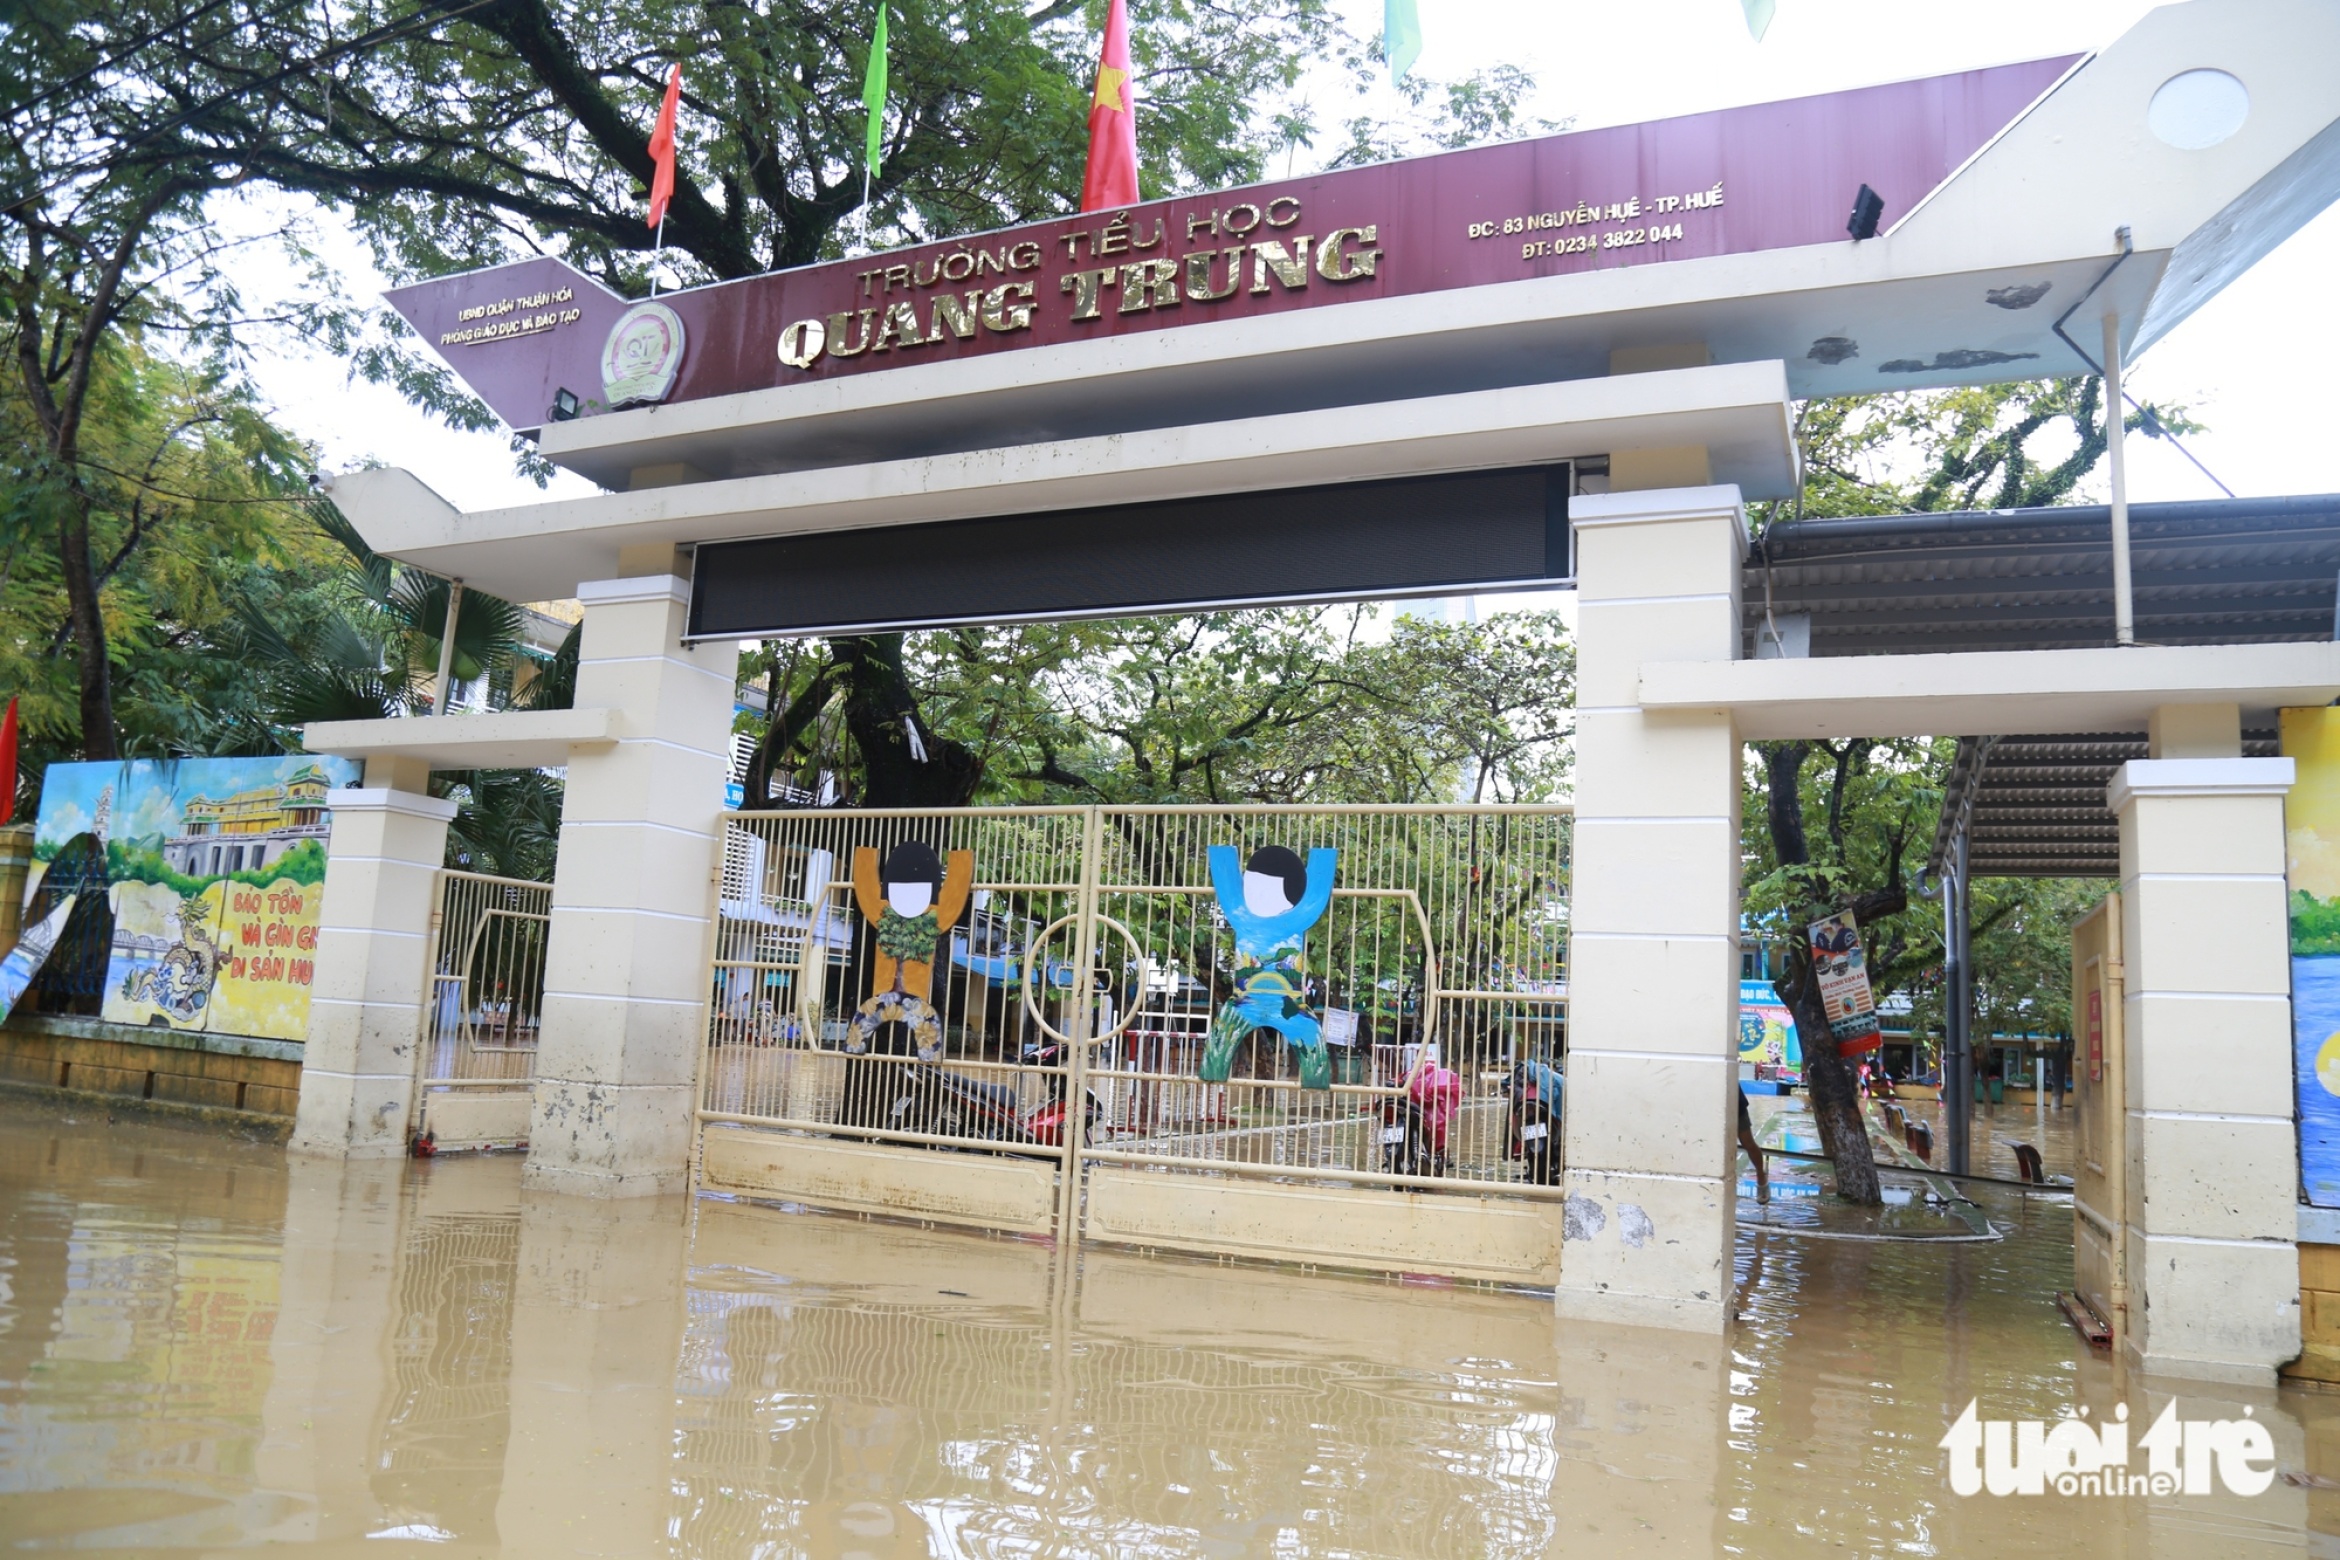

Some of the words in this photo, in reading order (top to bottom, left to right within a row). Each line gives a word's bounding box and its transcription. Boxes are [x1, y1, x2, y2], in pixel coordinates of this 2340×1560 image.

[1468, 220, 1500, 239] ĐC:
[1503, 217, 1524, 235] 83
[1527, 200, 1600, 232] NGUYỄN
[859, 241, 1041, 295] TRƯỜNG
[1059, 211, 1163, 260] TIỂU
[1187, 196, 1302, 240] HỌC
[1522, 240, 1551, 260] ĐT:
[1554, 235, 1598, 255] 0234
[1603, 229, 1646, 249] 3822
[1649, 222, 1684, 242] 044
[459, 305, 486, 322] UBND
[516, 291, 550, 310] THUẬN
[551, 286, 573, 303] HÓA
[777, 281, 1038, 370] QUANG
[1059, 224, 1383, 320] TRUNG
[441, 328, 473, 345] PHÒNG
[474, 322, 498, 339] GIÁO
[499, 319, 520, 336] DỤC
[522, 314, 534, 331] VÀ
[559, 307, 580, 326] TẠO
[233, 886, 262, 915] BẢO
[267, 886, 304, 915] TỒN
[241, 916, 262, 948] VÀ
[265, 917, 295, 948] GÌN
[230, 957, 247, 978] DI
[249, 949, 285, 982] SẢN
[288, 958, 314, 986] HU
